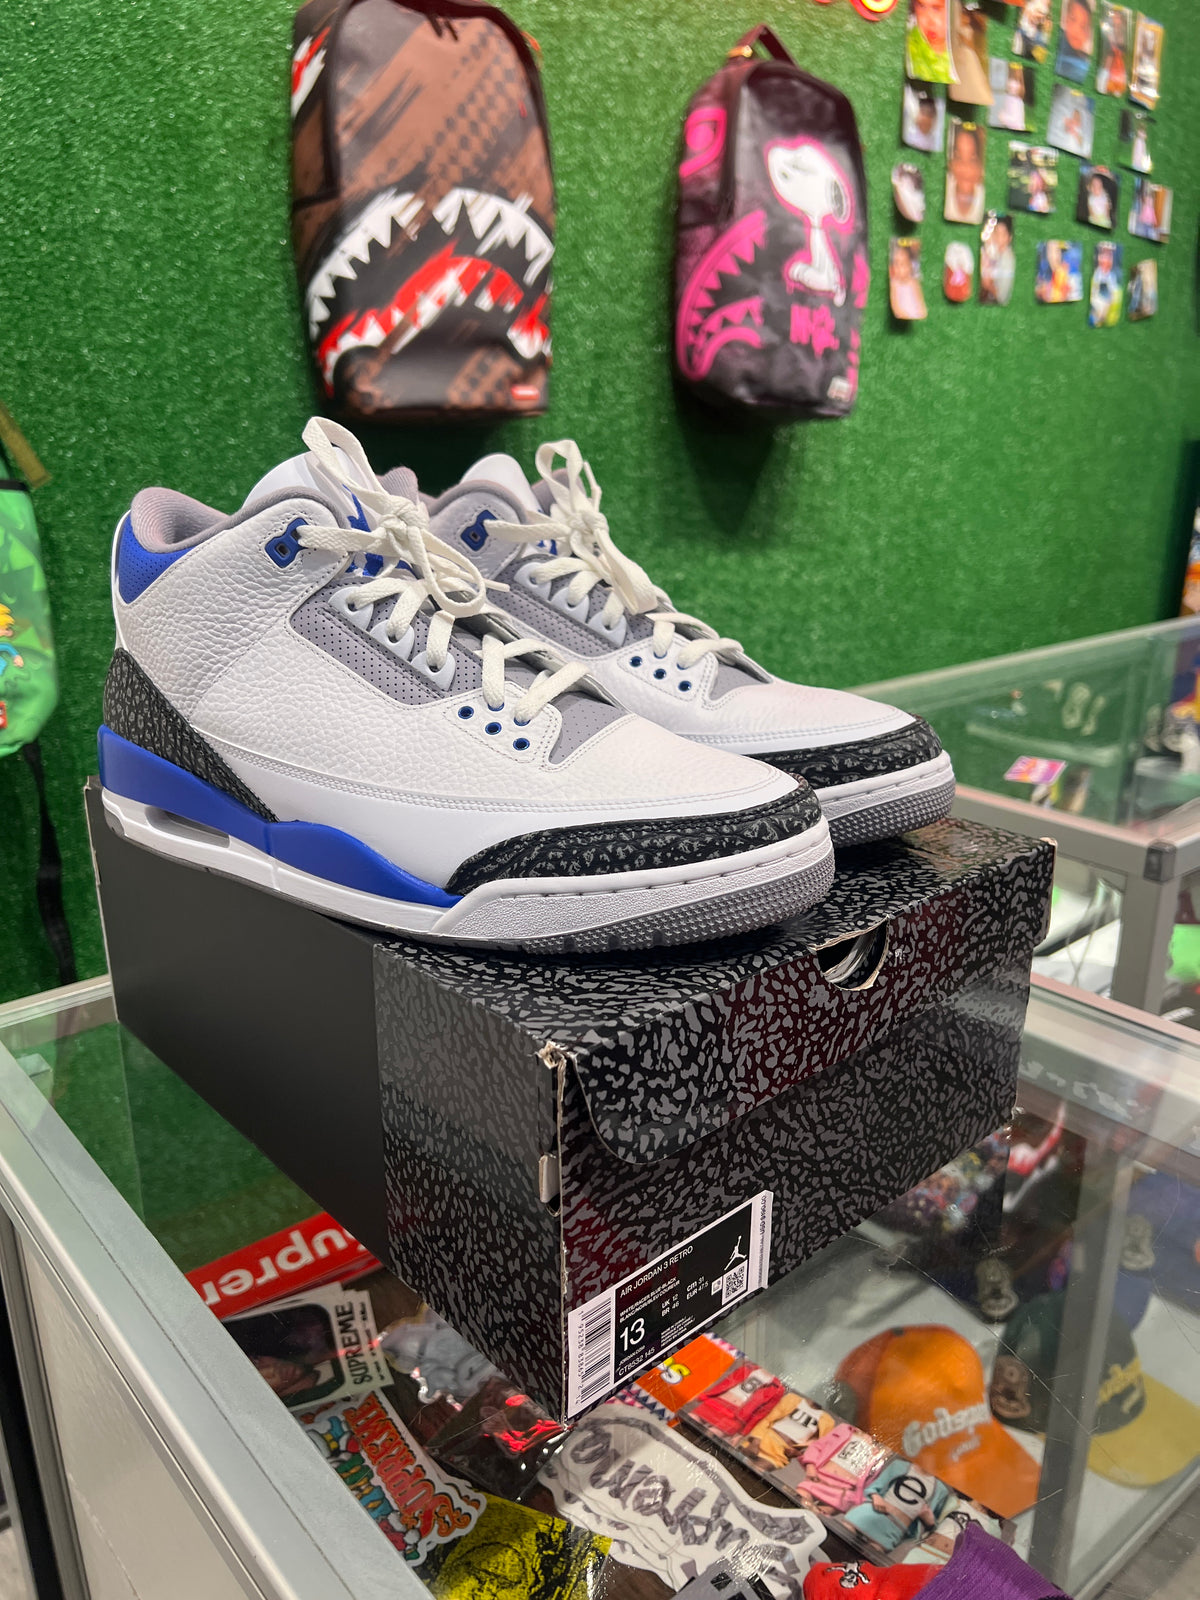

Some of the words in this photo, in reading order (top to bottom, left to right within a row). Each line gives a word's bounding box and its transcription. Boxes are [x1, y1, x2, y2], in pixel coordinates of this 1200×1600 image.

[202, 1228, 369, 1306] upre
[620, 1284, 632, 1298] AIR
[633, 1266, 662, 1289] JORDAN
[663, 1261, 668, 1270] 3
[669, 1245, 693, 1266] RETRO
[661, 1298, 670, 1309] UK
[672, 1293, 678, 1302] 12
[661, 1307, 670, 1317] BR
[672, 1301, 680, 1309] 46
[686, 1289, 697, 1300] EUR
[334, 1301, 372, 1385] SUPREME
[620, 1317, 645, 1351] 13
[618, 1355, 644, 1376] CT8532
[644, 1348, 655, 1360] 145
[790, 1408, 818, 1428] UP
[344, 1391, 472, 1538] SUPREME
[891, 1475, 927, 1506] e
